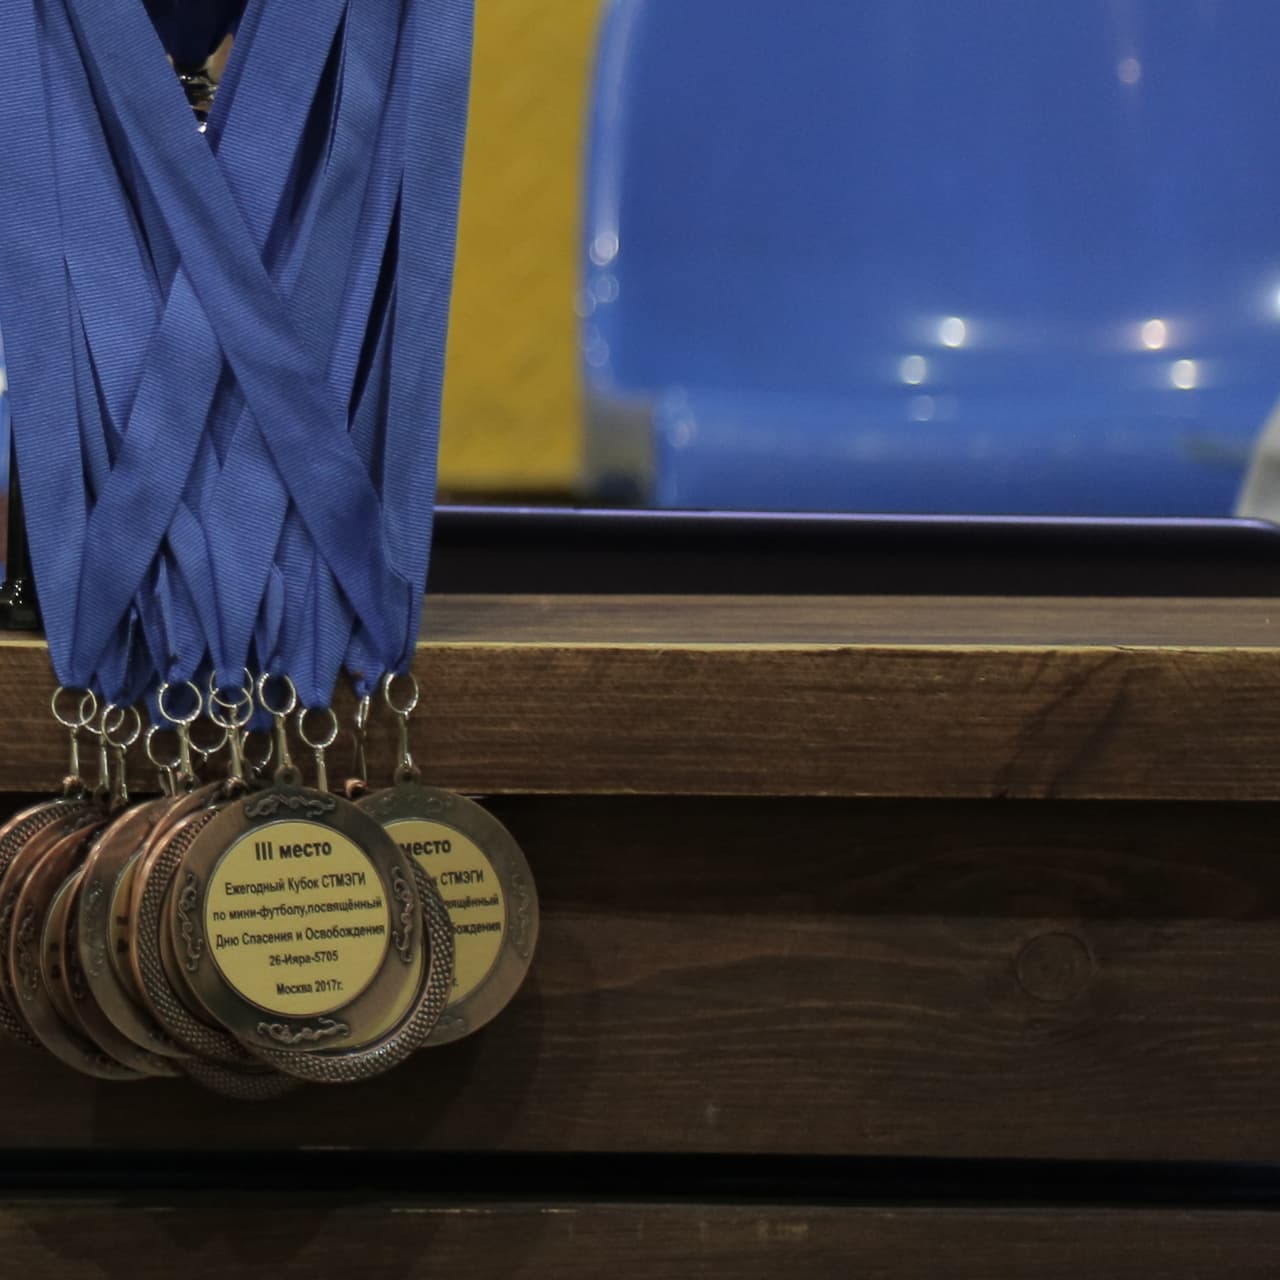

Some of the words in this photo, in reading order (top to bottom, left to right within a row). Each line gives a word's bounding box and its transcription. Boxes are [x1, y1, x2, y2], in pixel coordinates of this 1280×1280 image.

[255, 841, 273, 861] III
[279, 842, 331, 859] место
[225, 878, 284, 896] Ежегодный
[288, 876, 319, 893] Кубок
[322, 872, 366, 888] СТМЭГИ
[440, 869, 484, 886] СТМЭГИ
[213, 910, 226, 921] по
[216, 934, 239, 950] Дню
[242, 930, 293, 946] Спасения
[296, 932, 303, 941] и
[306, 924, 385, 941] Освобождения
[269, 950, 338, 967] 26-Ияра-5705
[277, 982, 313, 995] Москва
[315, 979, 343, 993] 2017г.
